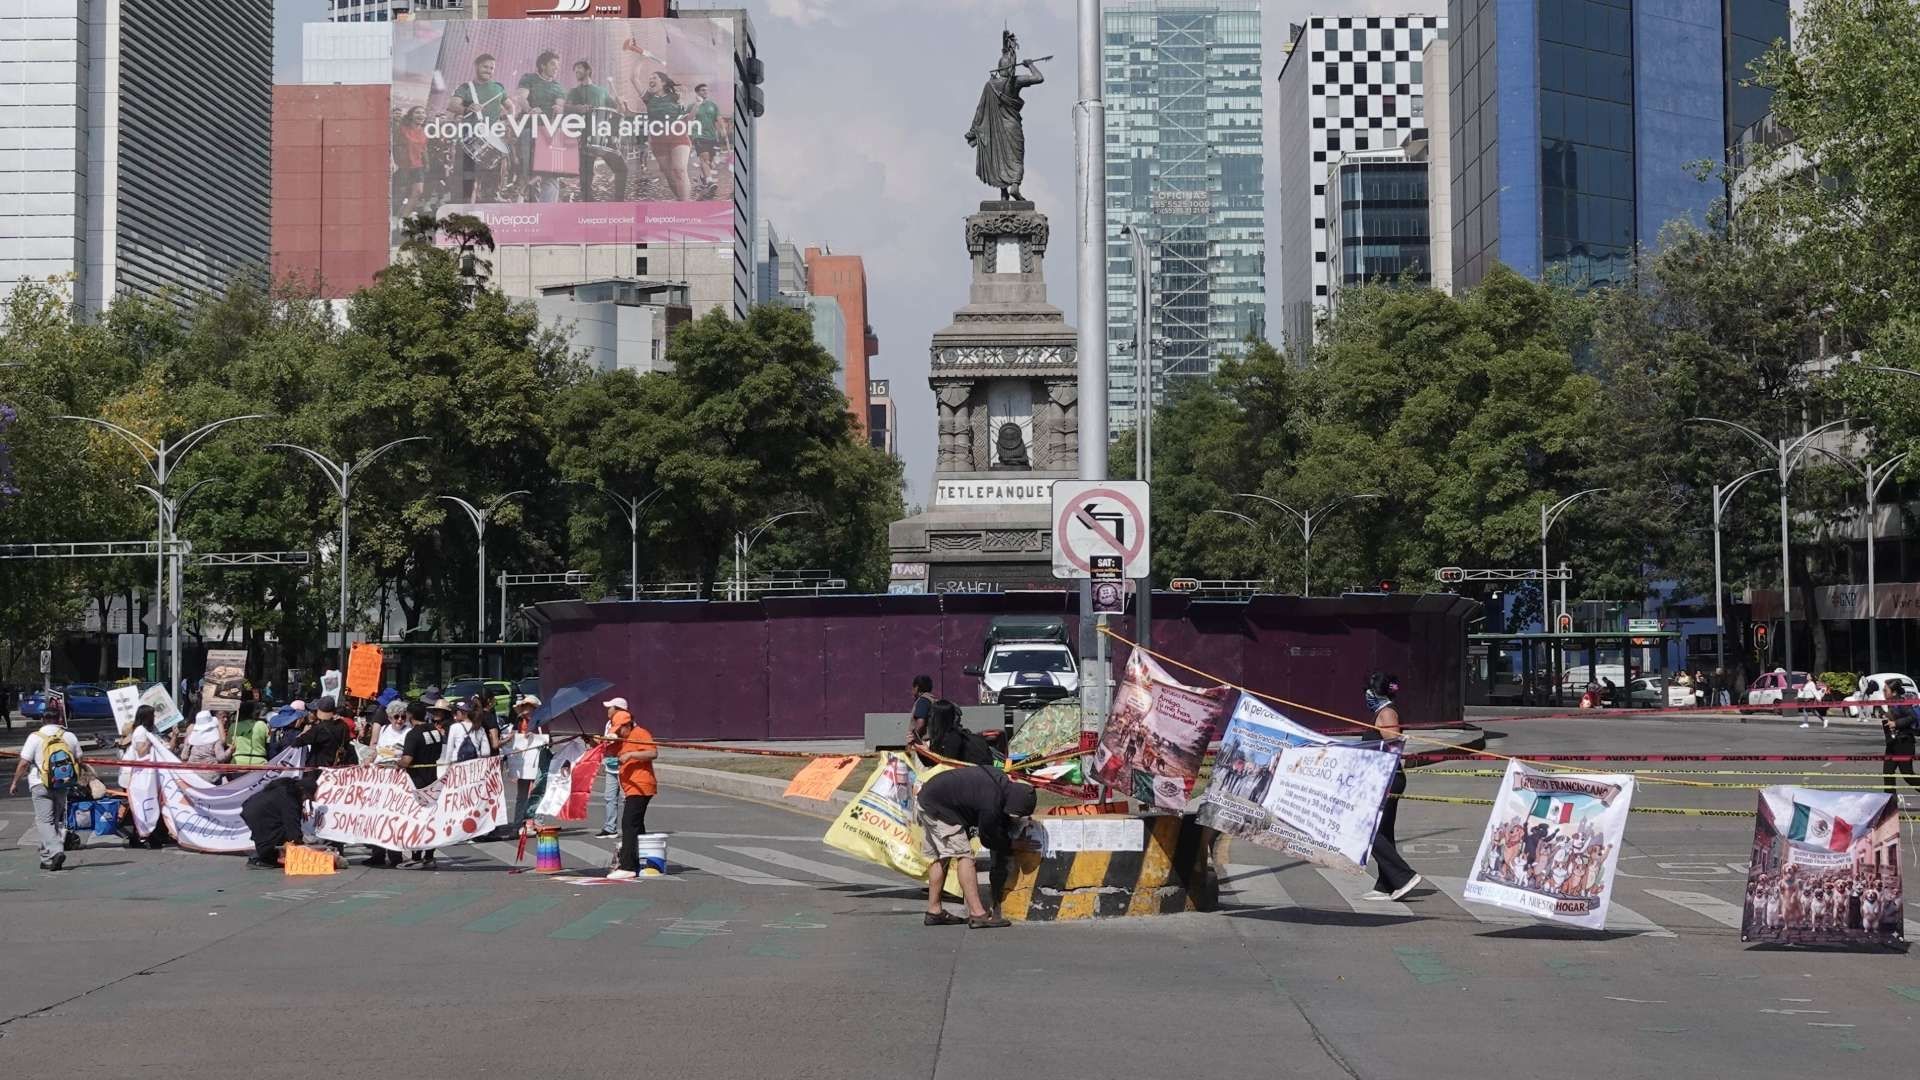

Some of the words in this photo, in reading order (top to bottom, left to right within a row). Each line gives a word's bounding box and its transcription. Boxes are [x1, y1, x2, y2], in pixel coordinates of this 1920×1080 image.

[424, 117, 506, 139] donde
[507, 113, 586, 138] vive
[591, 119, 612, 137] la
[618, 114, 703, 137] afición
[486, 212, 540, 226] Liverpool
[1839, 592, 1857, 607] GNP
[1549, 780, 1609, 797] FRANCISCANO
[842, 821, 858, 834] Tres
[862, 811, 892, 831] SON
[1270, 825, 1297, 839] Estamos
[1297, 833, 1327, 849] luchando
[1327, 843, 1341, 853] por
[1288, 842, 1314, 857] ustedes
[1556, 901, 1586, 912] HOGAR
